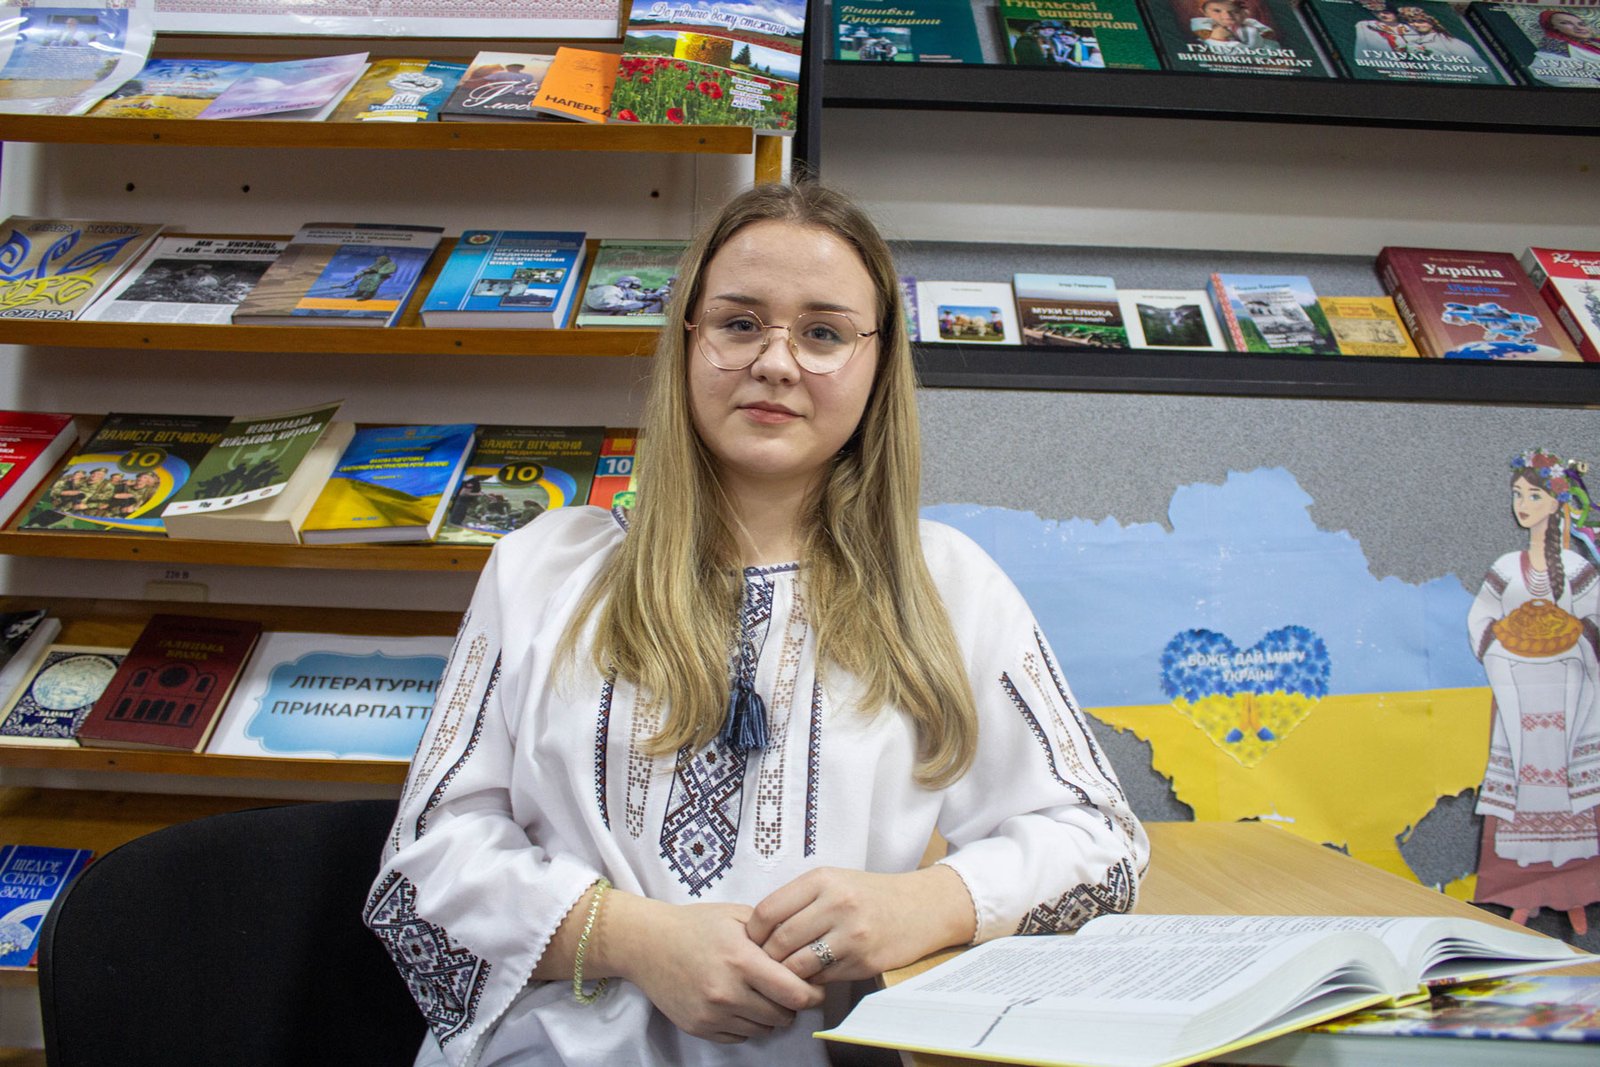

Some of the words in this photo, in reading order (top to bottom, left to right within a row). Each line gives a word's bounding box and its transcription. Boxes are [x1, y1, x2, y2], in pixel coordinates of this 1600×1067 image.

[195, 240, 214, 248] МИ
[1422, 263, 1504, 279] Україна
[1, 308, 75, 321] СЛАВА
[1031, 306, 1063, 315] МУКИ
[1064, 308, 1114, 318] СЕЛЮКА
[96, 429, 152, 441] ЗАХИСТ
[219, 433, 275, 448] ВІЙСЬКОВА
[479, 439, 526, 450] ЗАХИСТ
[526, 439, 583, 450] ВІТЧИЗНИ
[126, 451, 161, 467] 10
[606, 458, 632, 474] 10
[504, 466, 539, 481] 10
[1233, 652, 1264, 666] ДАЙ
[1222, 669, 1275, 682] УКРАЇНІ
[271, 700, 432, 720] ПРИКАРПАТТ
